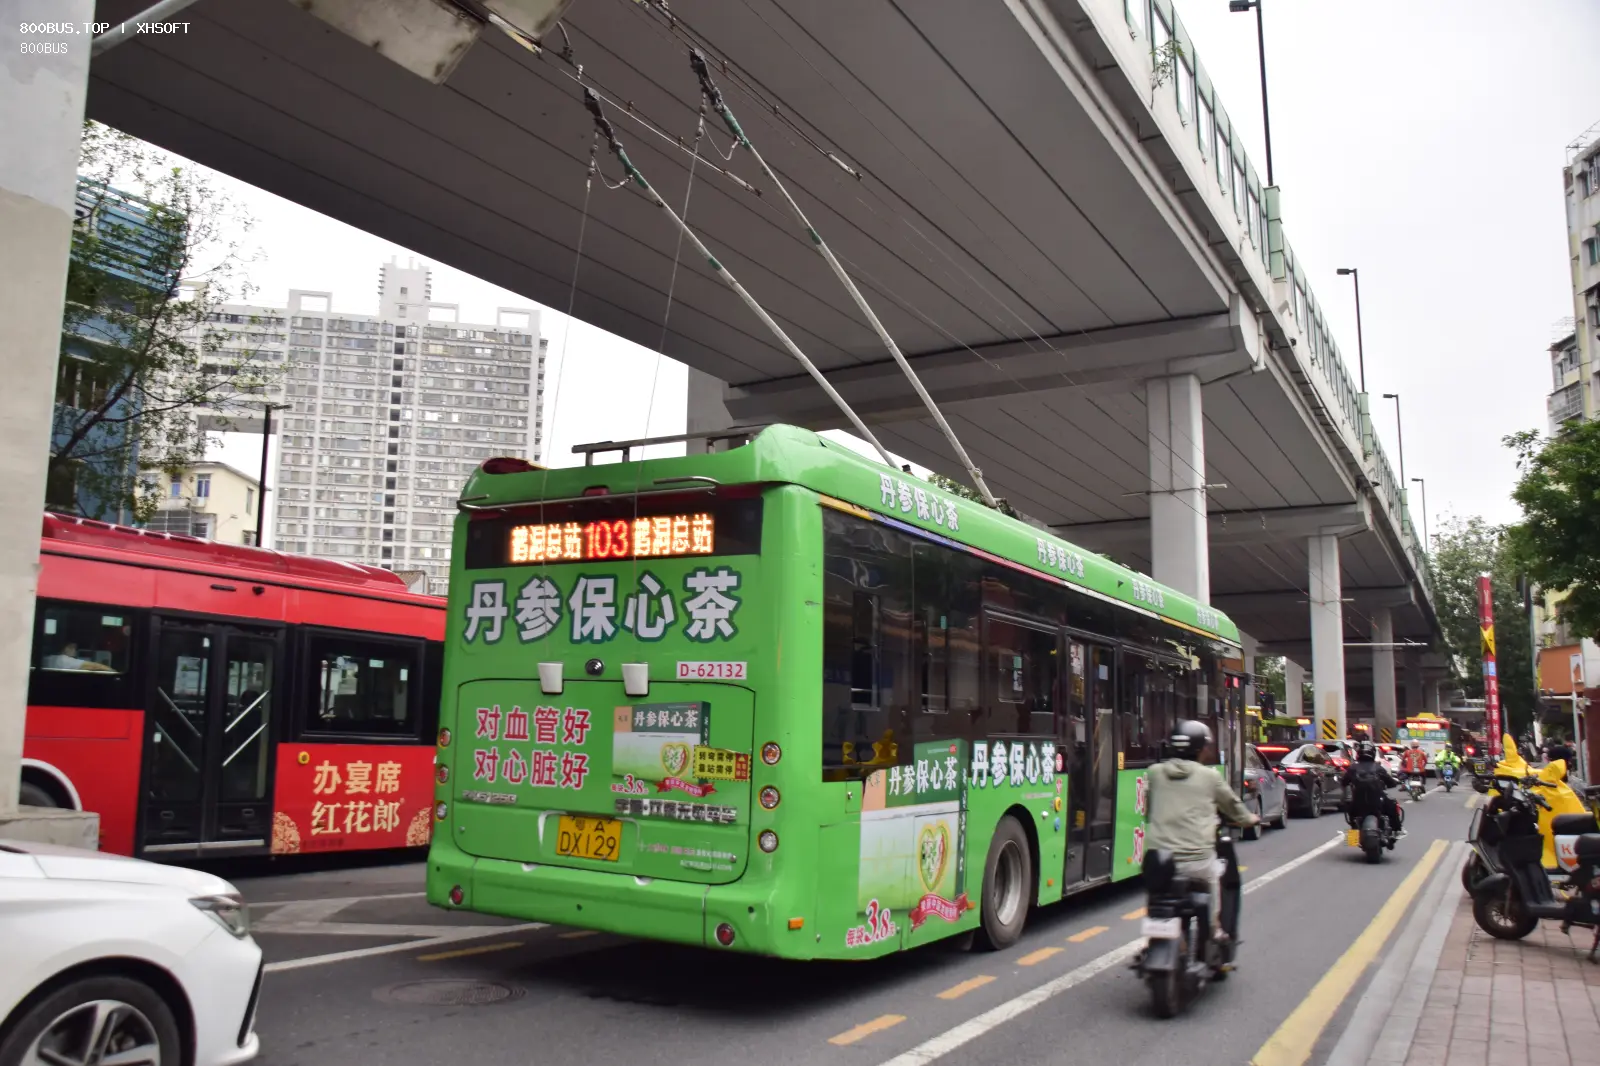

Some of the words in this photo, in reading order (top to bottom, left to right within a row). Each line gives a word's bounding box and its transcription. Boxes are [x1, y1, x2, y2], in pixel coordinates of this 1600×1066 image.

[878, 472, 960, 533] 丹参保心茶
[584, 520, 628, 558] 103
[1036, 537, 1085, 579] 丹参保心茶
[462, 569, 740, 643] 丹参保心茶
[680, 662, 744, 678] D-62132
[475, 704, 592, 745] 对血管好
[633, 709, 699, 728] 丹参保心茶
[312, 759, 402, 795] 办宴席
[473, 747, 591, 790] 对心脏好
[888, 756, 958, 796] 丹参保心茶
[970, 739, 1056, 789] 丹参保心茶
[310, 799, 401, 836] 红花郎
[559, 831, 617, 857] DX129
